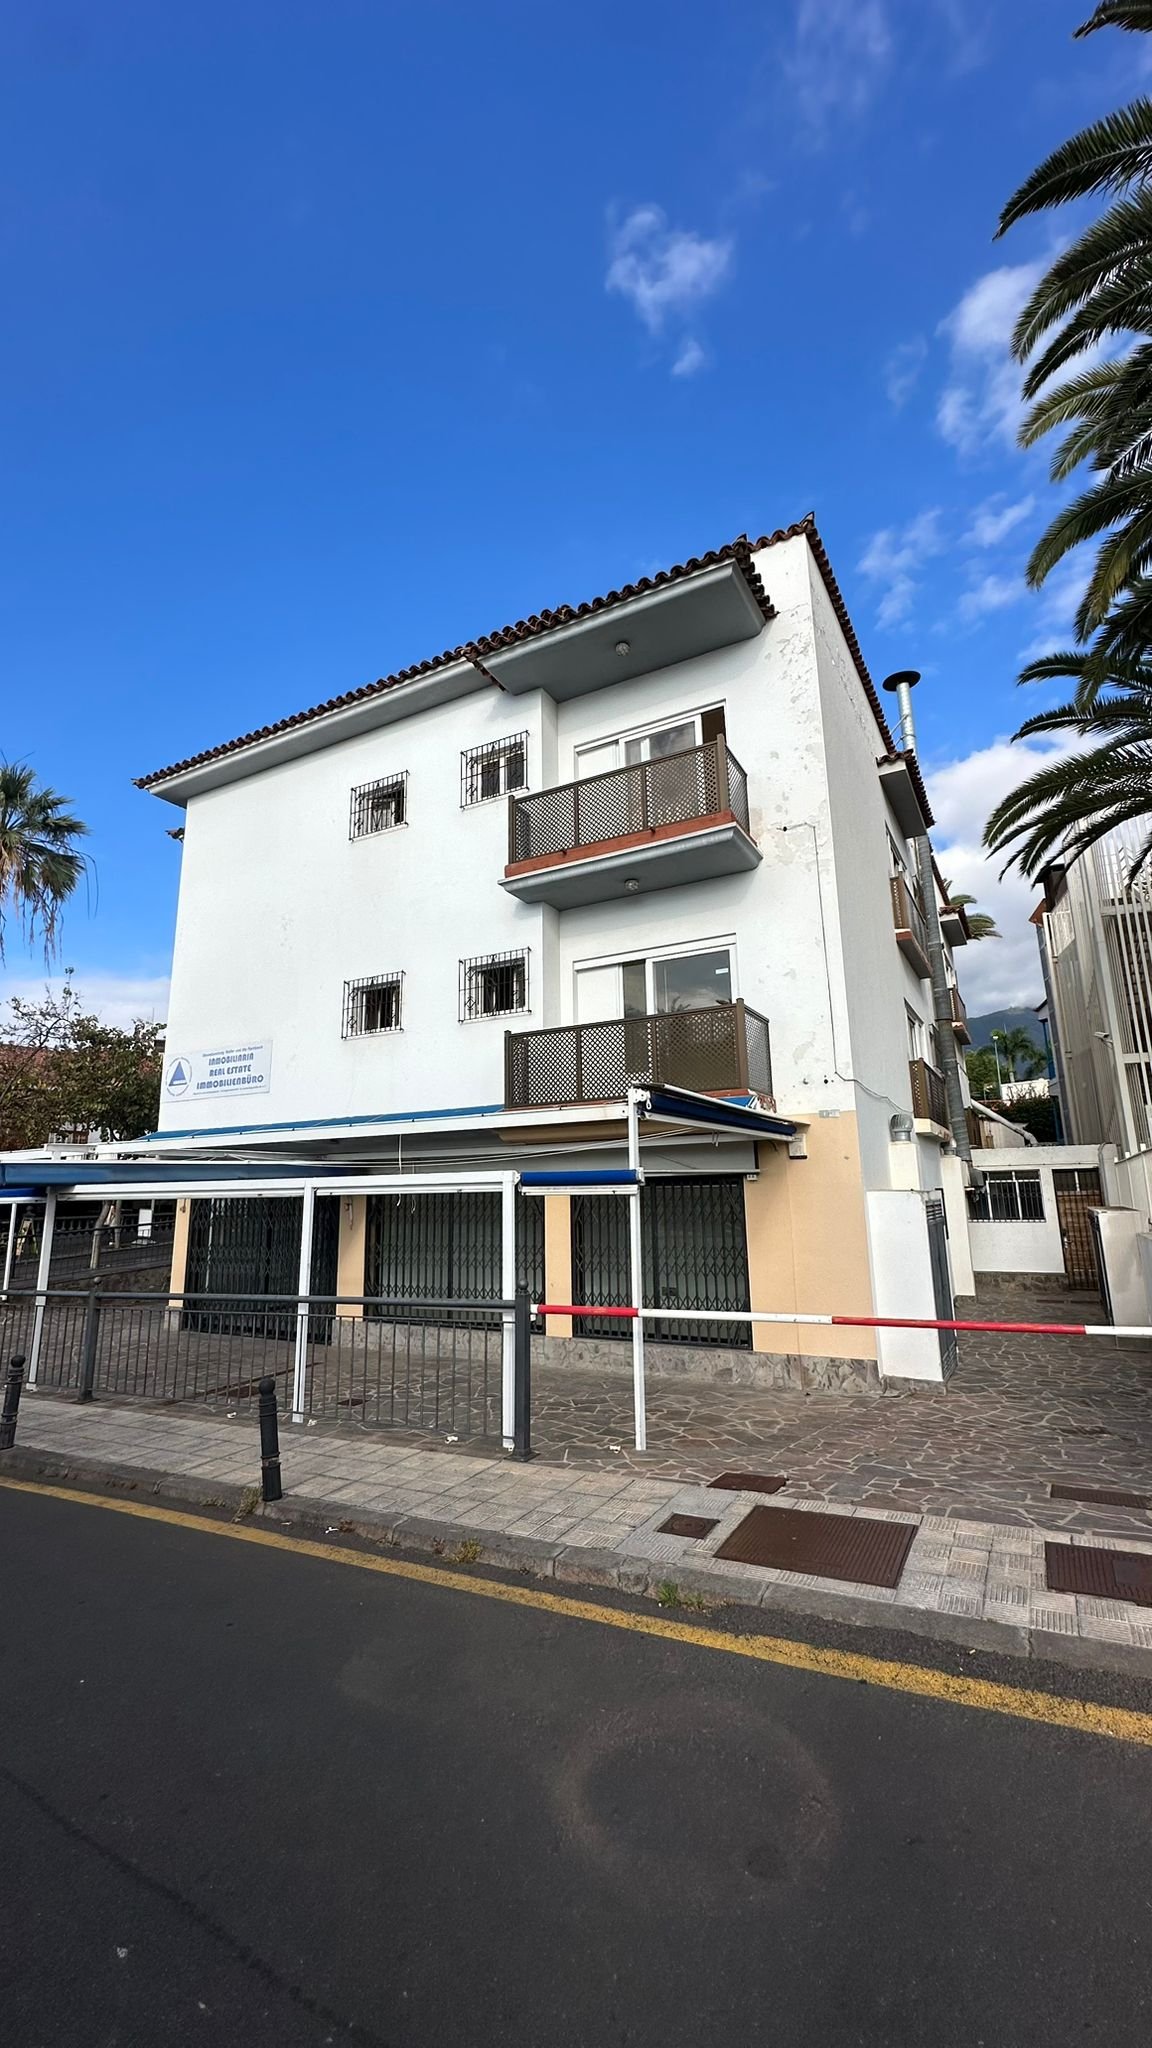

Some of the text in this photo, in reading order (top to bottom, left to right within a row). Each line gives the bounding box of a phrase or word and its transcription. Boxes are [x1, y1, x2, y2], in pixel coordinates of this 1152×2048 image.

[208, 1052, 254, 1066] INMOBILIARIA
[209, 1064, 252, 1077] REAL ESTATE
[196, 1074, 264, 1090] IMMOBILIENBÜRO
